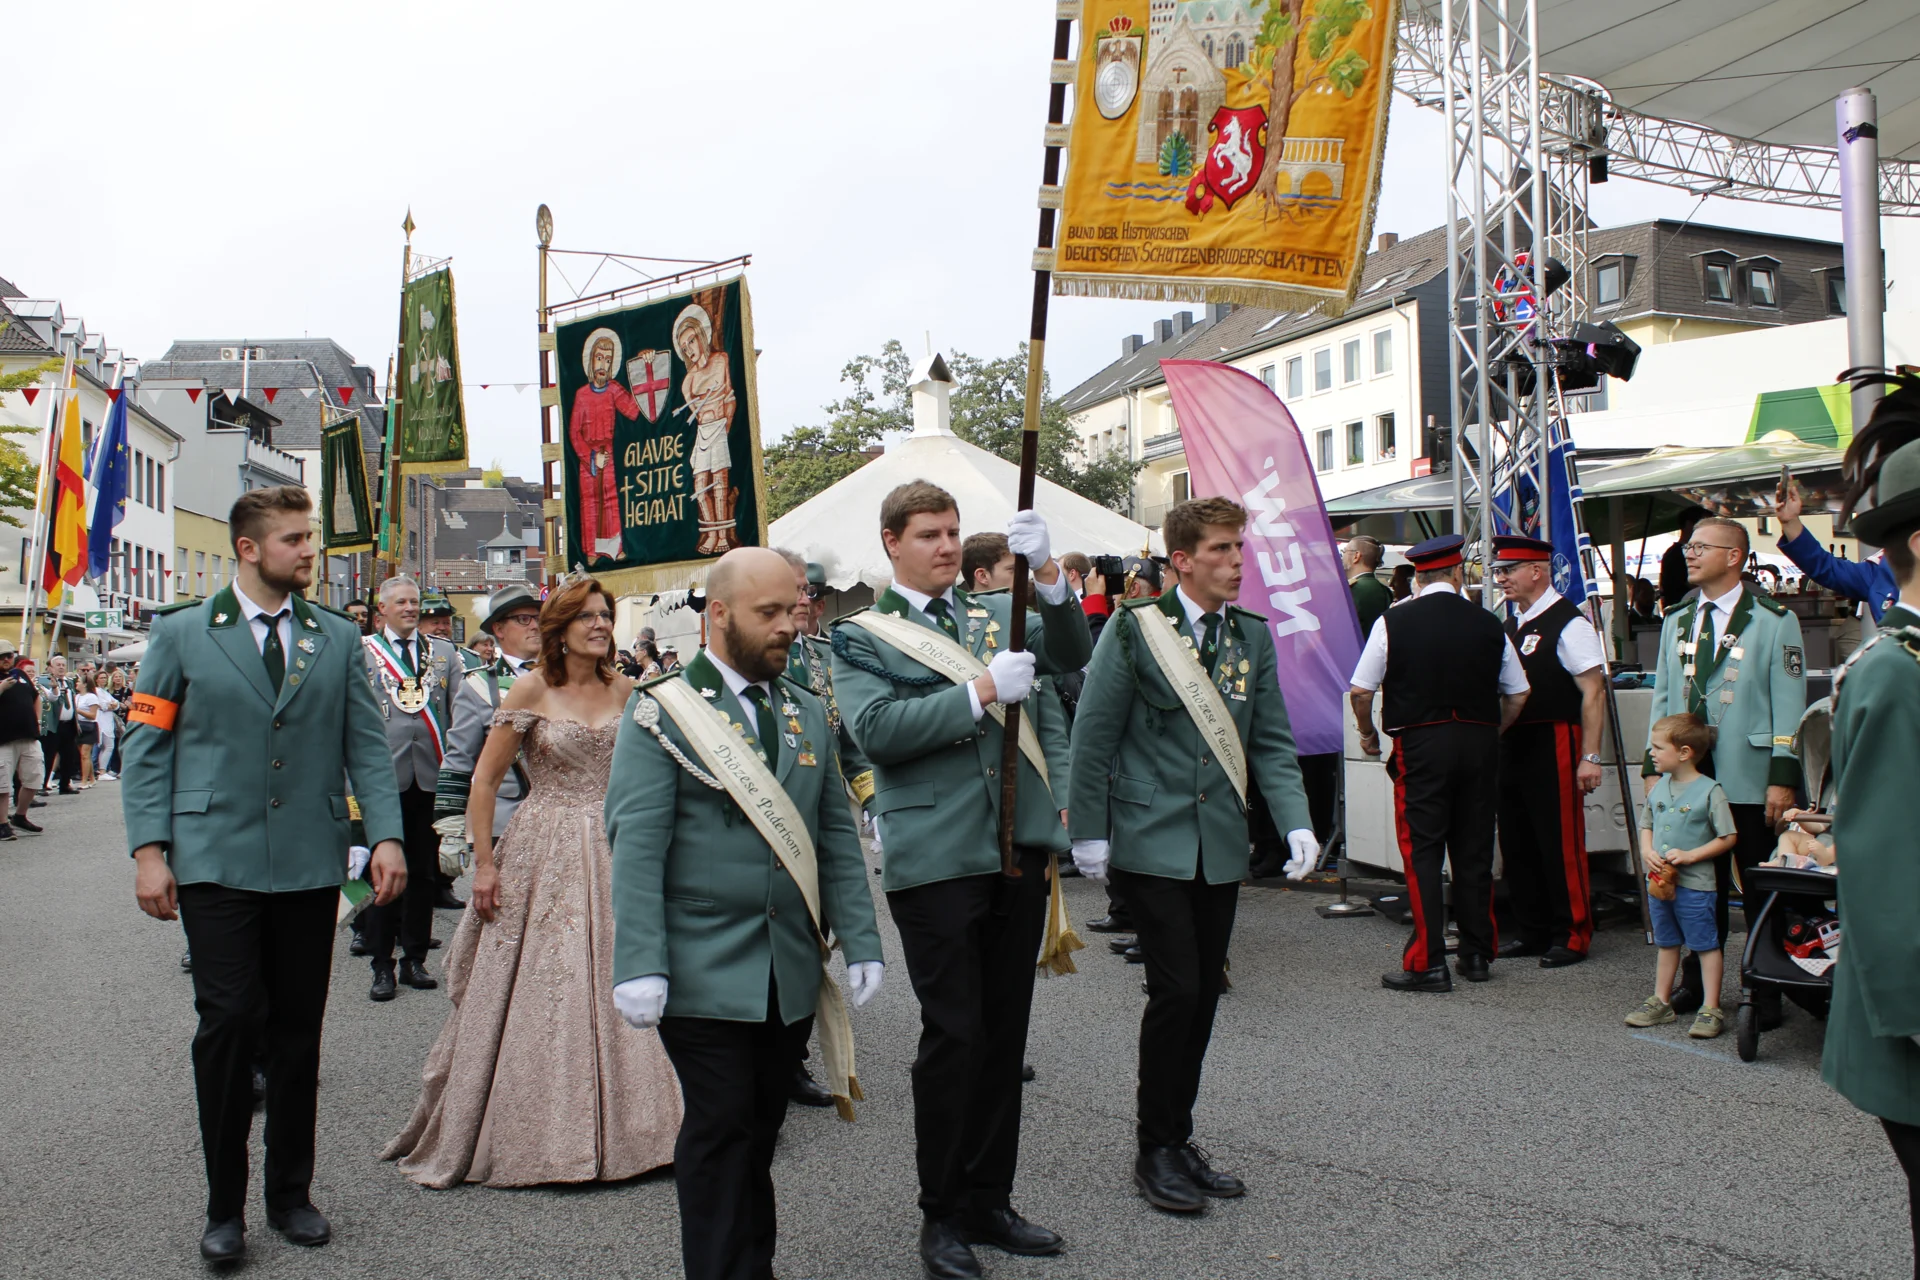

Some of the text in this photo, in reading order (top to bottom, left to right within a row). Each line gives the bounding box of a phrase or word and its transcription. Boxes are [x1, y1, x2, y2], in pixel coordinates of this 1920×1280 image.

[1067, 226, 1095, 240] BUND
[1097, 226, 1119, 240] DER
[1064, 245, 1139, 262] DEUTSCHEN
[624, 493, 687, 529] HEIMAT
[917, 641, 966, 673] Diözese
[1185, 681, 1217, 724] Diözese
[713, 744, 802, 859] Diözese Paderborn
